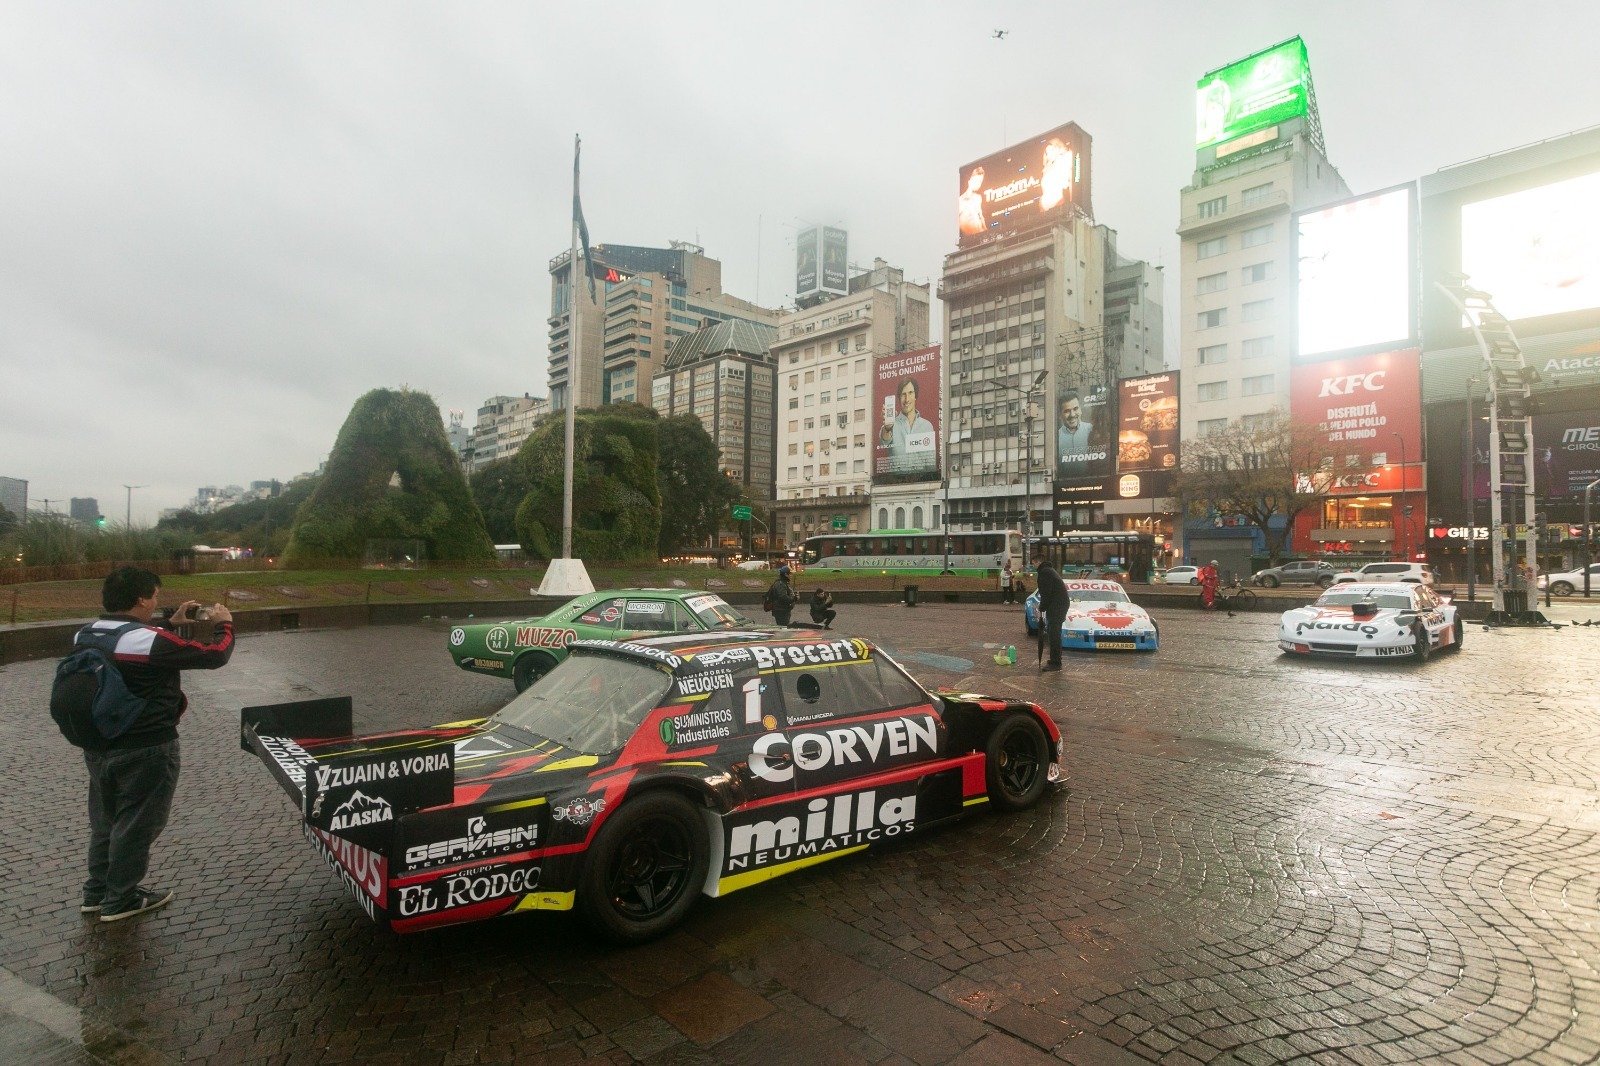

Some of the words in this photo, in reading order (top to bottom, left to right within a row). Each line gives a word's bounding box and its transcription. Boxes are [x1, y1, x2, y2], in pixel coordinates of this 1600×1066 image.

[879, 360, 905, 371] HACETE
[905, 353, 935, 366] CLIENTE
[879, 369, 898, 380] 100%
[898, 363, 928, 376] ONLINE.
[1318, 370, 1386, 397] KFC
[1327, 401, 1377, 420] DISFRUTÁ
[1329, 431, 1343, 441] DEL
[1346, 428, 1377, 439] MUNDO
[1330, 419, 1358, 431] MEJOR
[1359, 416, 1386, 428] POLLO
[1062, 451, 1106, 462] RITONDO
[1334, 473, 1380, 488] KFC
[1429, 528, 1434, 538] I
[1325, 542, 1353, 551] KFC
[514, 627, 577, 649] MUZZO
[619, 642, 682, 669] TRUCKS
[749, 640, 858, 669] Brocart
[1375, 645, 1413, 656] INFINIA
[678, 673, 734, 695] NEUQUEN
[743, 678, 762, 725] 1
[674, 708, 733, 730] SUMINISTROS
[676, 725, 730, 745] Industriales
[749, 716, 938, 783] CORVEN
[388, 760, 399, 779] &
[401, 752, 450, 776] VORIA
[329, 807, 394, 831] ALASKA
[729, 791, 917, 857] milla
[405, 824, 538, 864] GERVASINI
[728, 821, 916, 871] NEUMATICOS
[408, 840, 537, 871] NEUMATICOS
[458, 864, 493, 878] GRUPO
[399, 884, 438, 916] EL
[445, 866, 542, 908] RODEO
